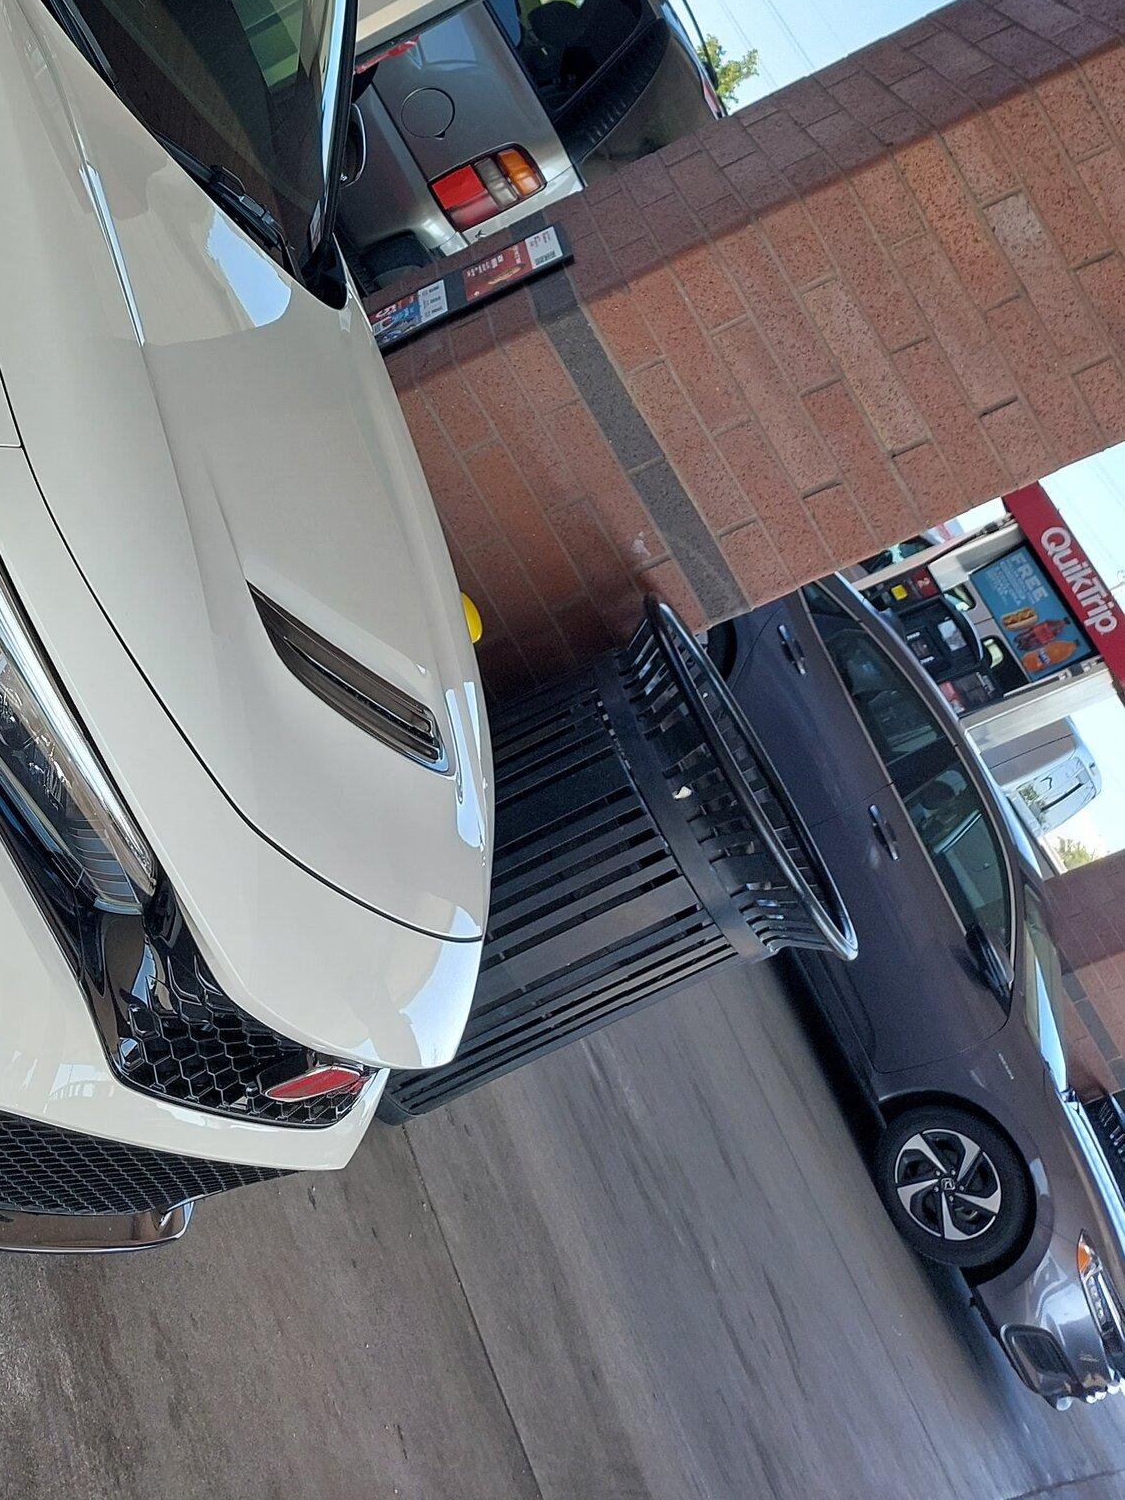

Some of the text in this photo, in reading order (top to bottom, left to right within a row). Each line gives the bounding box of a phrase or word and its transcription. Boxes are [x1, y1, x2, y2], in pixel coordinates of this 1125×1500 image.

[916, 576, 931, 588] 2
[1008, 552, 1048, 601] FREE
[1042, 526, 1116, 632] QuikTrip
